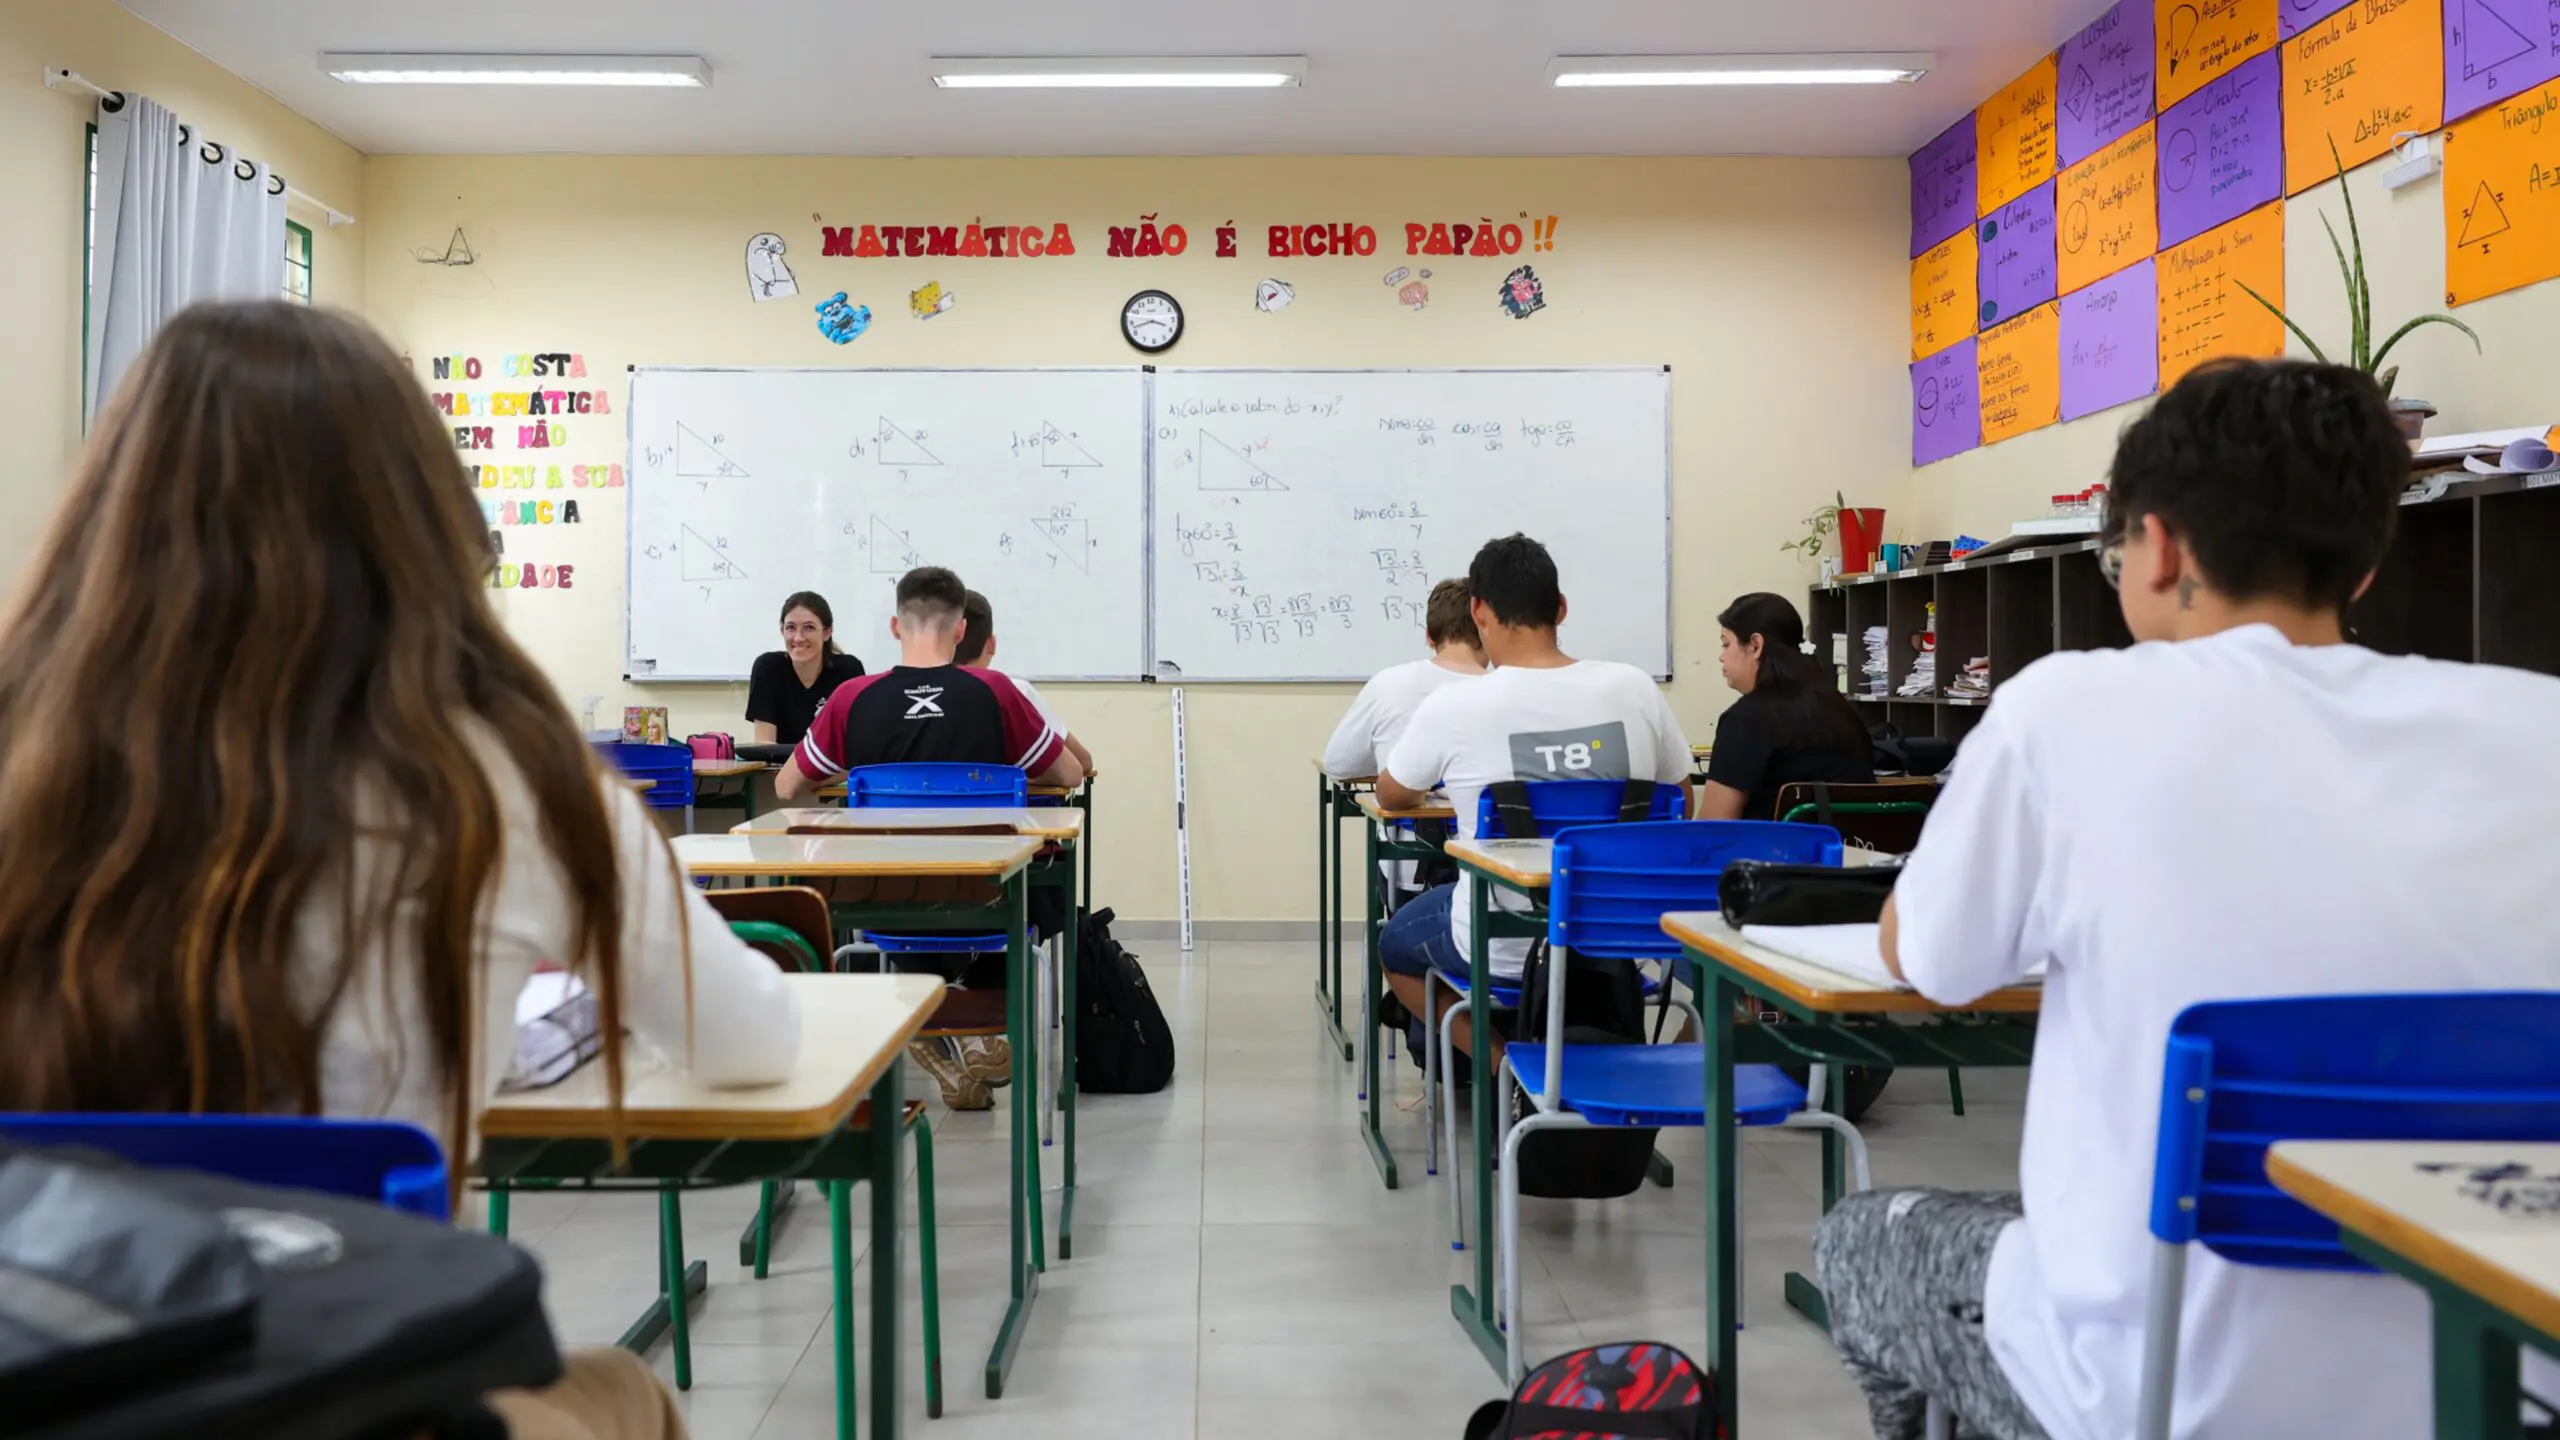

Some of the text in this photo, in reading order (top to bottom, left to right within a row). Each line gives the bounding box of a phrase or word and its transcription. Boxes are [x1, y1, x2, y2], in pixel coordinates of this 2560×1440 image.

[2299, 18, 2340, 62] Fórmula
[2346, 9, 2357, 33] de
[2488, 72, 2497, 89] b
[2499, 90, 2558, 135] Triângulo
[1108, 214, 1188, 256] NÃO
[1215, 217, 1236, 256] É
[1268, 223, 1377, 257] BICHO
[433, 350, 482, 380] NÃO
[432, 385, 611, 416] MATEMÁTICA
[448, 419, 566, 450] EM NÃO
[463, 464, 625, 489] NDEU A SUA
[480, 500, 581, 525] TANCIA
[484, 562, 574, 589] IDADE
